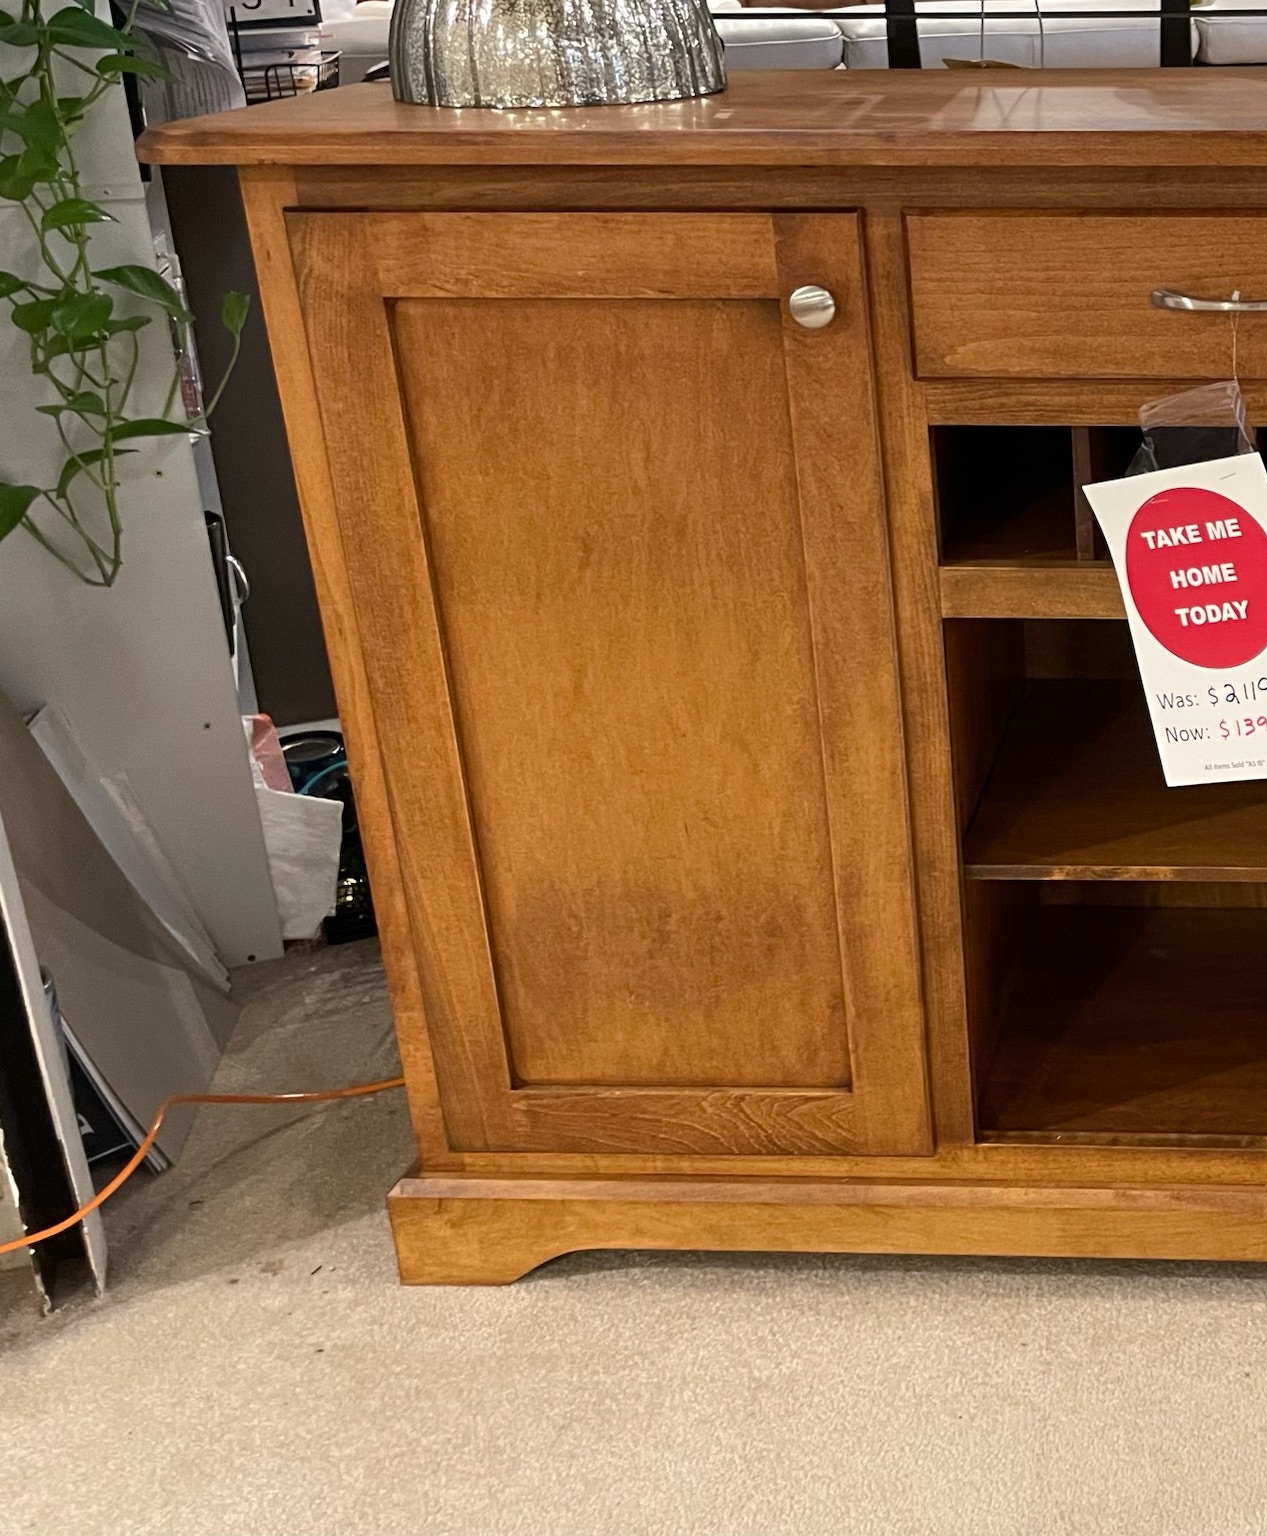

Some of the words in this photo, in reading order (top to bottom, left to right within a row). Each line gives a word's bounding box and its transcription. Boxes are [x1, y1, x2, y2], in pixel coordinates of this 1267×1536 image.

[1140, 523, 1202, 550] TAKE
[1205, 518, 1242, 541] ME
[1170, 562, 1238, 589] HOME
[1174, 600, 1249, 627] TODAY
[1155, 692, 1200, 710] Was:
[1165, 726, 1211, 743] Now:
[1231, 761, 1245, 769] Sold
